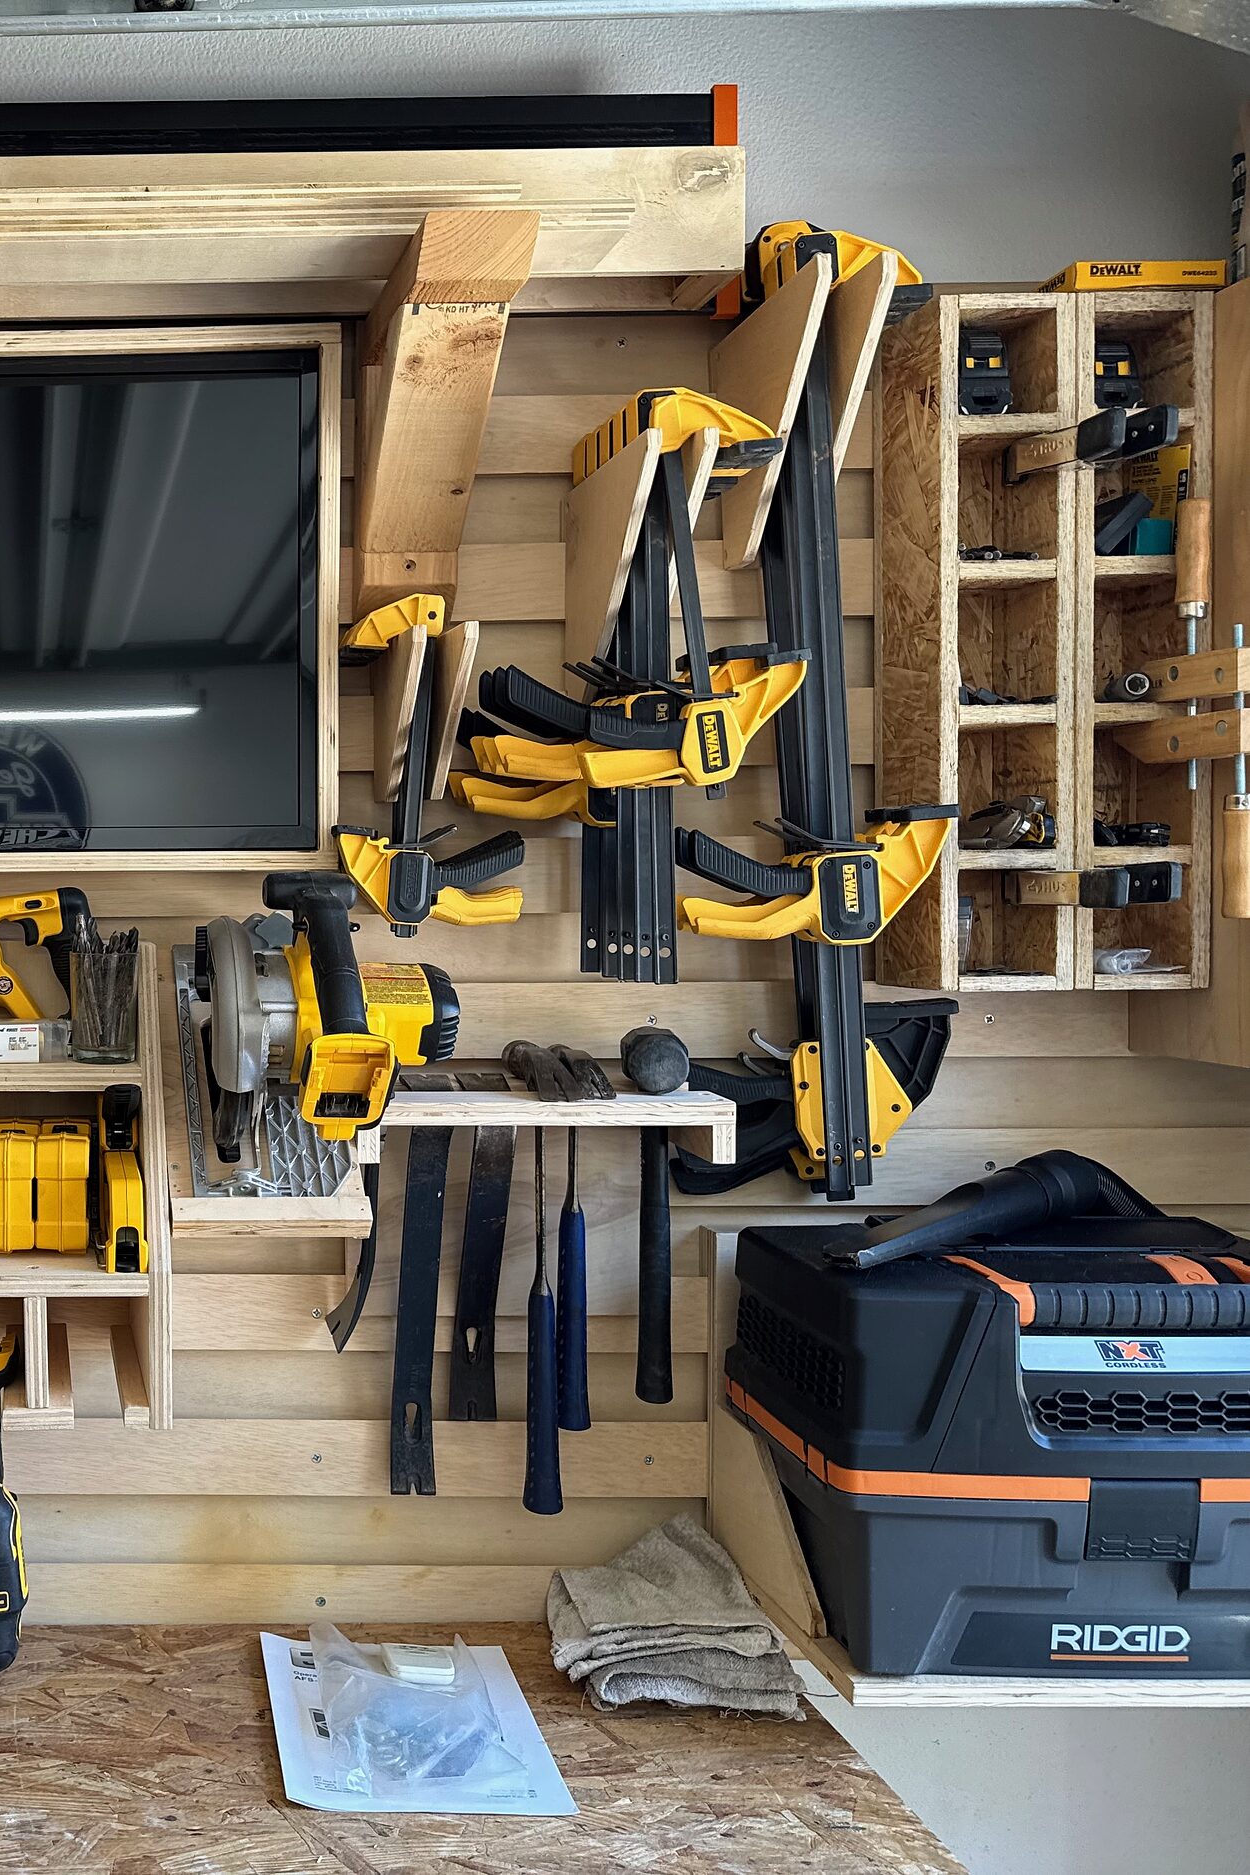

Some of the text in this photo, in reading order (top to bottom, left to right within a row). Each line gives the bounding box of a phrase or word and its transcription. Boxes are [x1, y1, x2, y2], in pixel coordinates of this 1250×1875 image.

[1089, 264, 1142, 277] DEWALT
[702, 714, 723, 768] DEWALT
[842, 864, 859, 914] DEWALT
[1095, 1340, 1164, 1361] NXT
[1050, 1623, 1192, 1653] RIDGID
[293, 1670, 318, 1678] Opera
